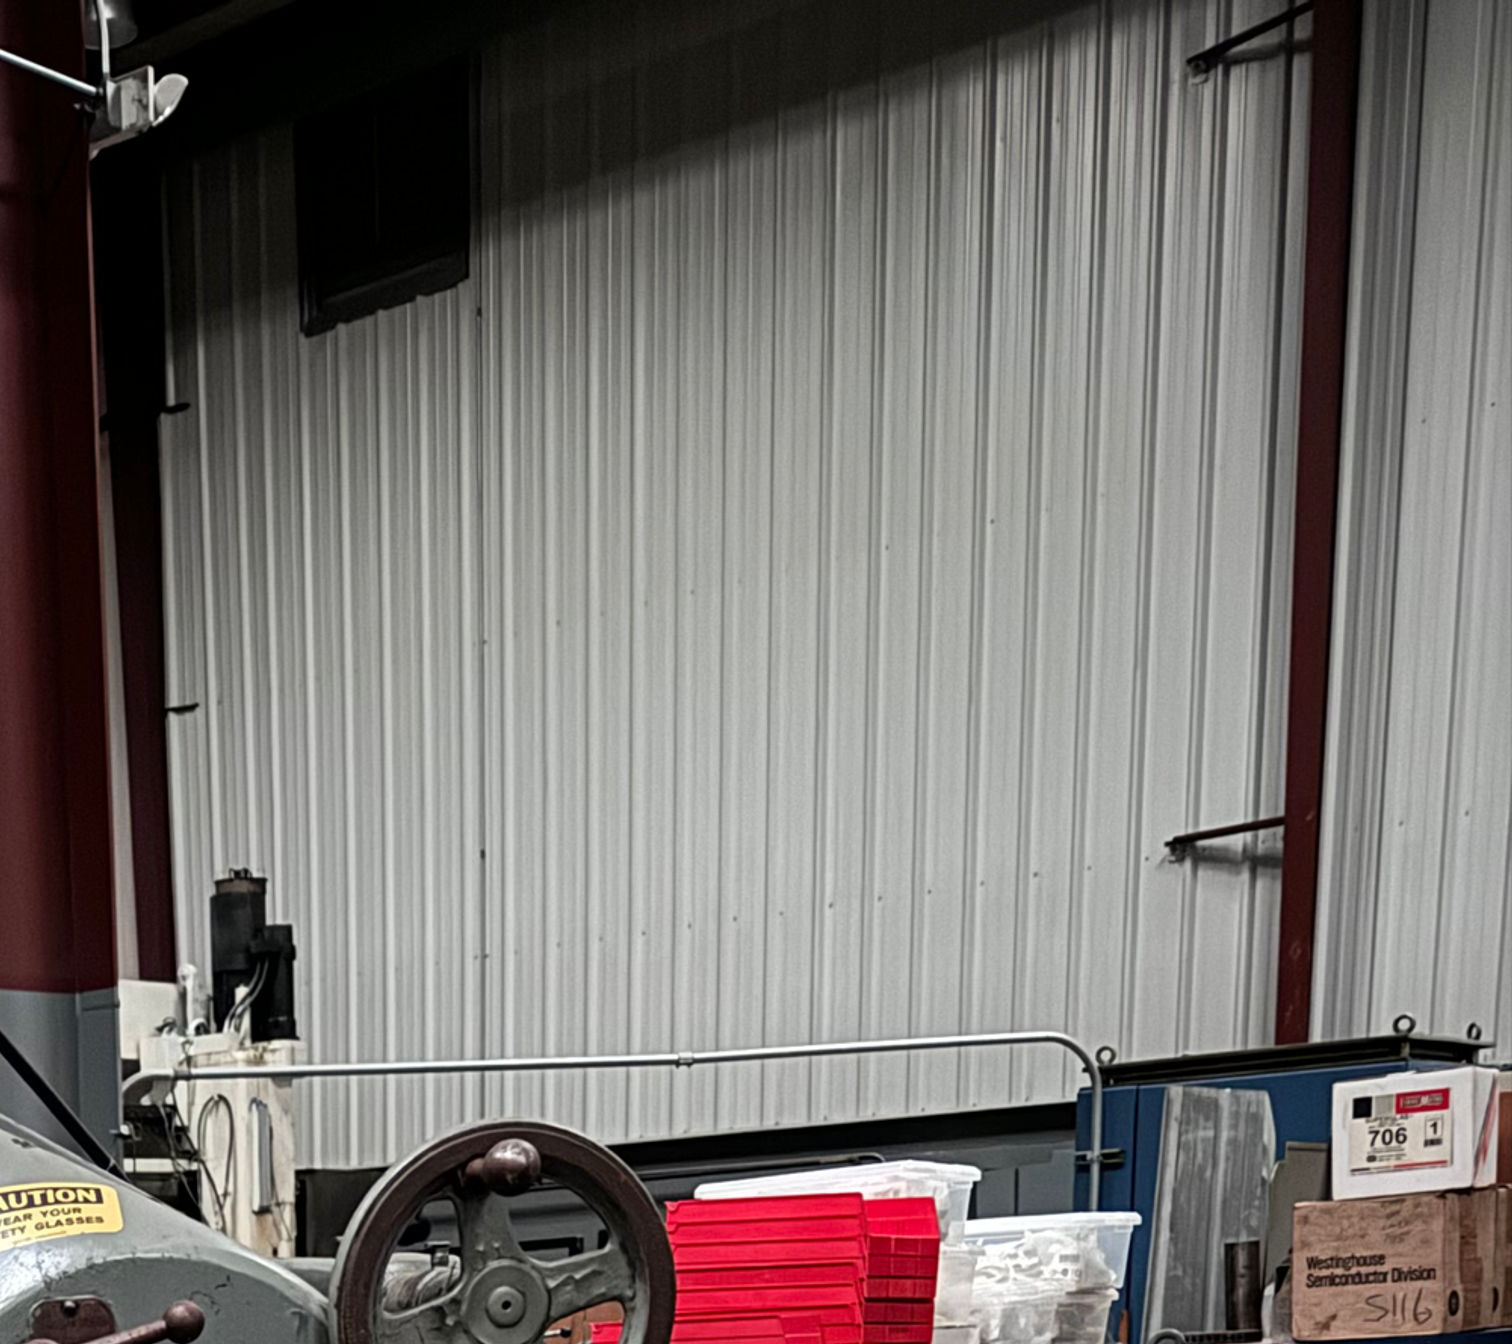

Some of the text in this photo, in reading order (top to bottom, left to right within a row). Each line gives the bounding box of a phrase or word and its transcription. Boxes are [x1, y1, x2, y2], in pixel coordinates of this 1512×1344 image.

[1429, 1121, 1439, 1136] 1
[1368, 1127, 1408, 1147] 706
[39, 1206, 83, 1219] YOUR
[34, 1216, 105, 1231] GLASSES
[1305, 1253, 1387, 1271] Westinghouse
[1305, 1266, 1437, 1289] Semiconductor Division
